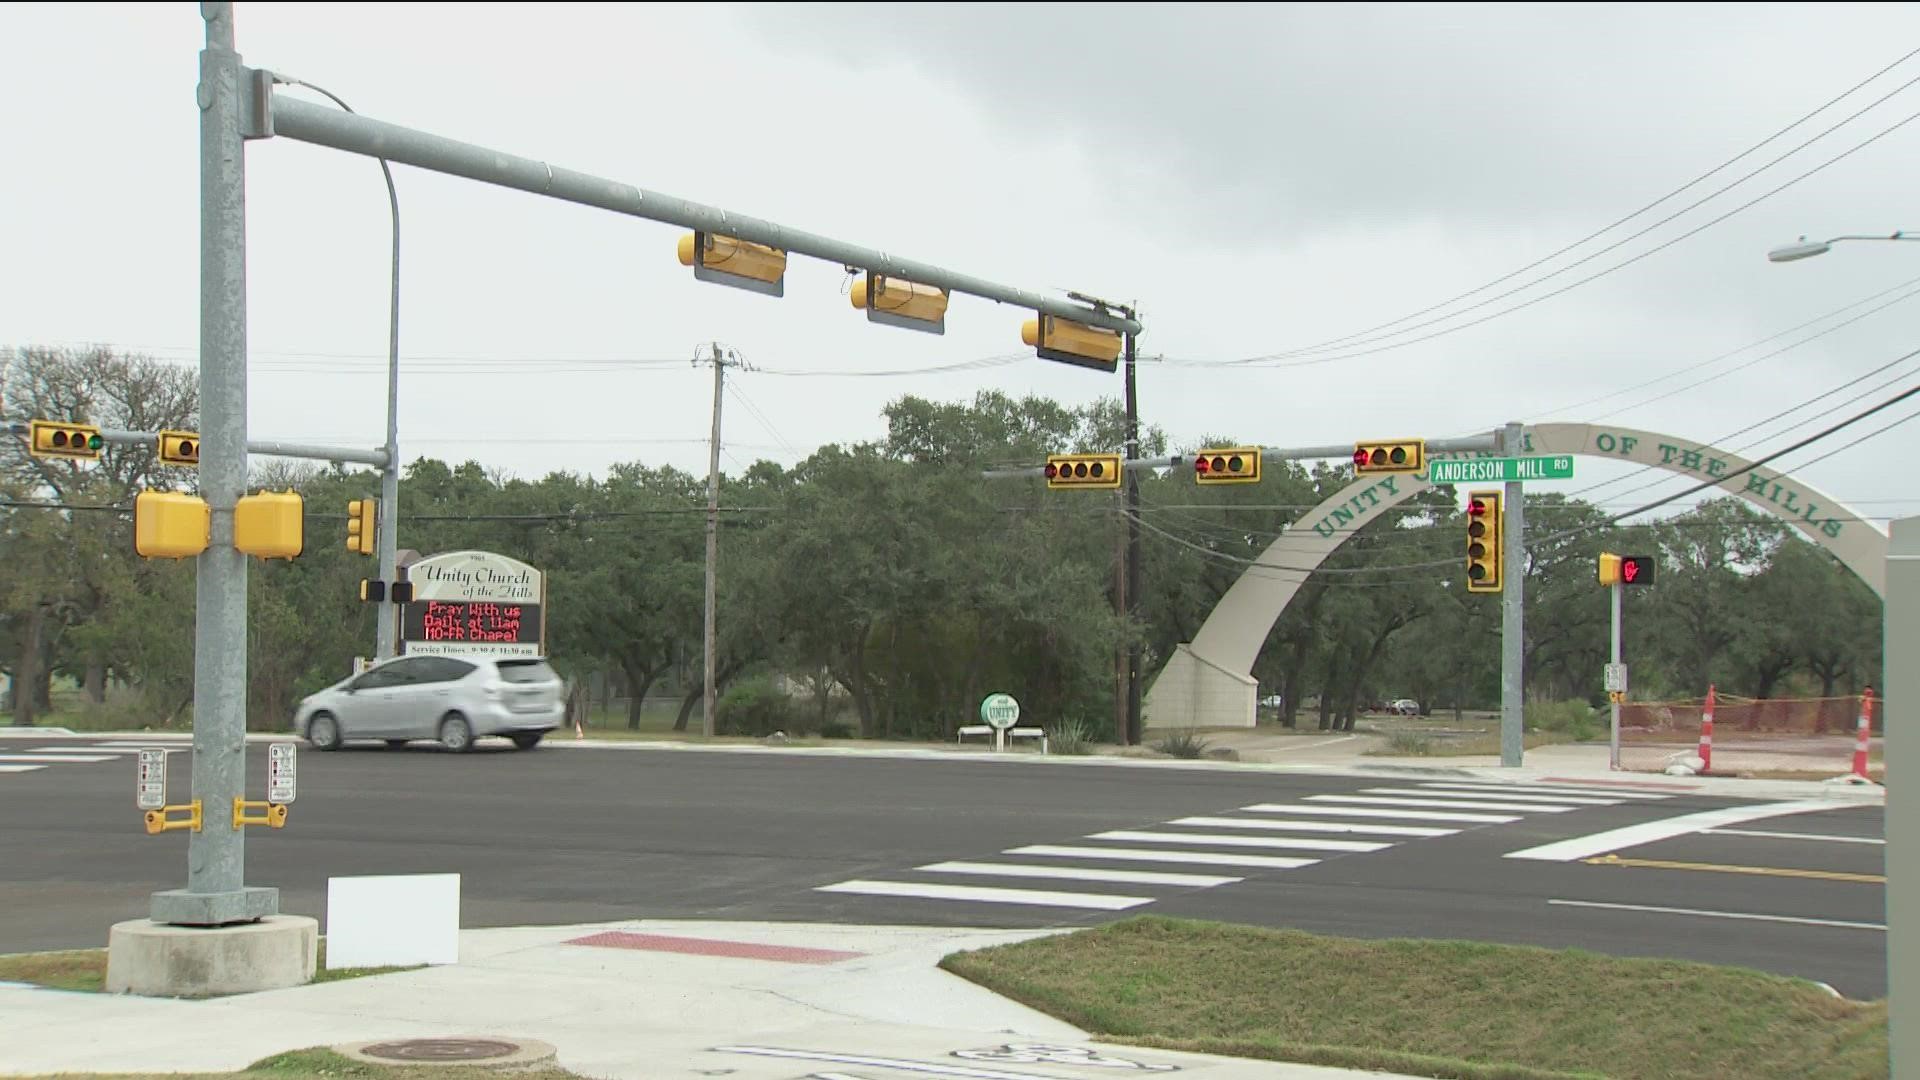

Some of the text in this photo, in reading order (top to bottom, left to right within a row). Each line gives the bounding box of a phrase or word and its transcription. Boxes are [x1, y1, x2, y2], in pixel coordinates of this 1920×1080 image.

[1435, 458, 1569, 480] ANDERSON MILL RD
[1312, 433, 1842, 538] UNITY OF THE HILLS
[420, 566, 530, 585] Unity Church
[462, 585, 533, 599] of the Hills
[428, 601, 520, 617] Pray With us
[424, 614, 461, 629] Daily
[468, 616, 483, 629] at
[470, 628, 517, 641] Chapel
[411, 645, 440, 653] Service
[988, 704, 1017, 718] UNITY
